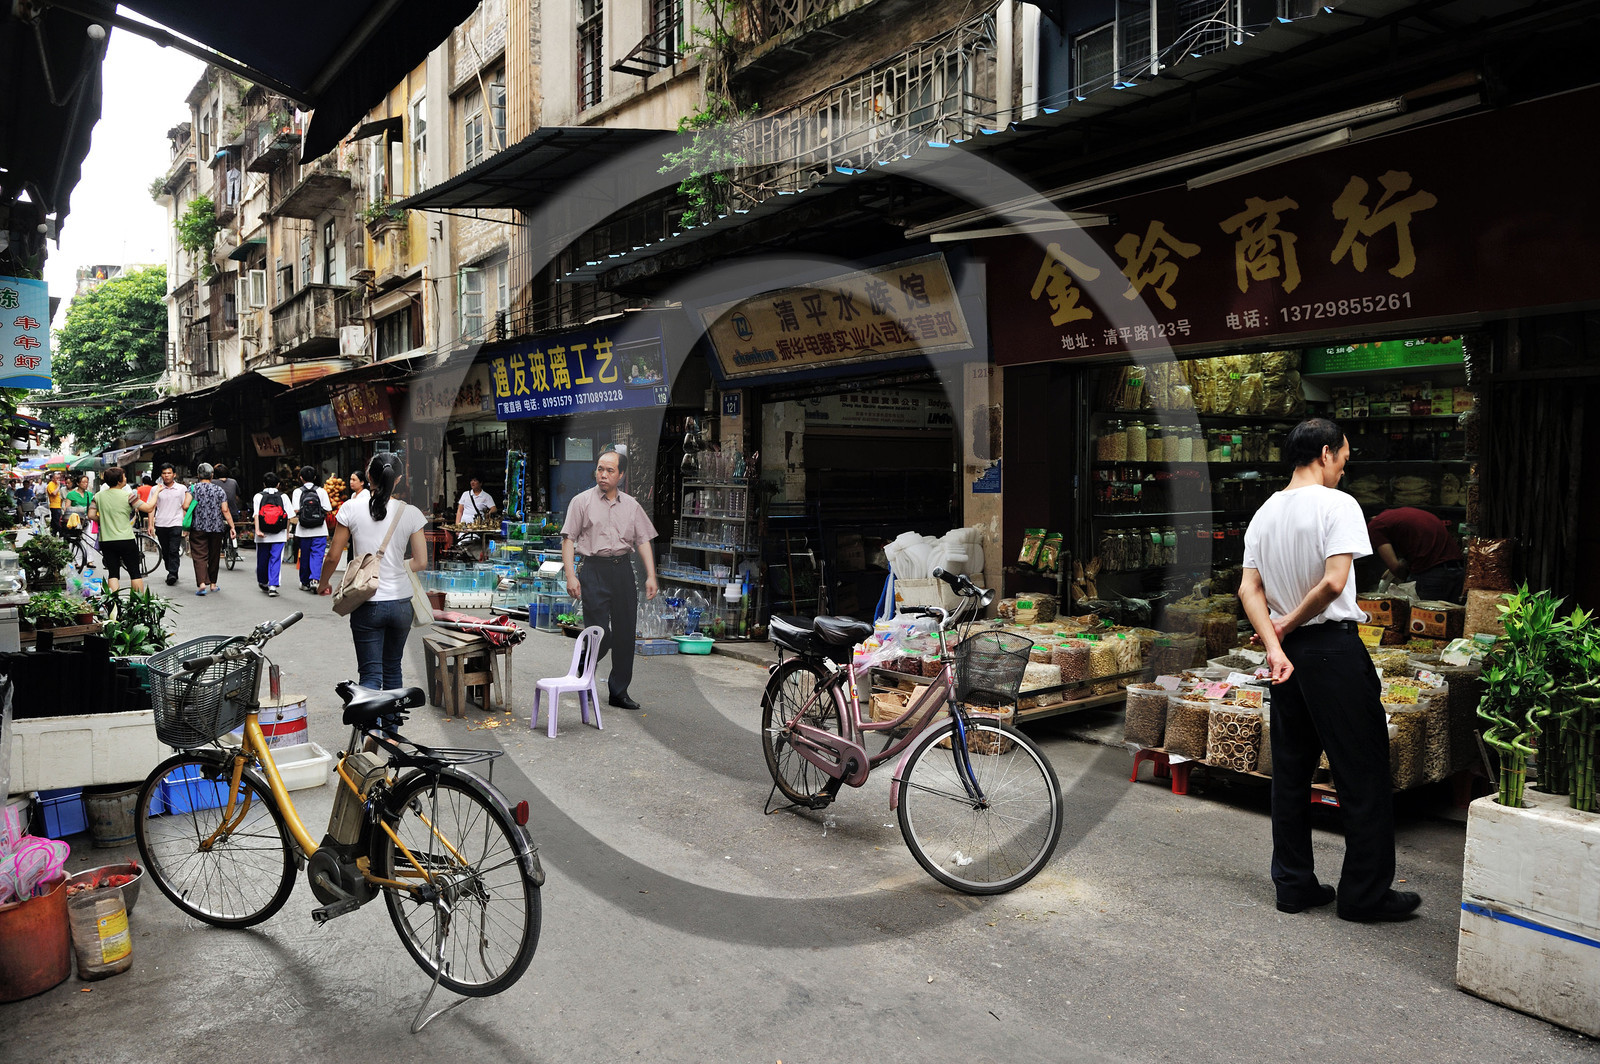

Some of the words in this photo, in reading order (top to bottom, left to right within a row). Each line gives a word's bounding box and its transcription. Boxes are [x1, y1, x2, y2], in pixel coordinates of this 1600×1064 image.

[1030, 169, 1439, 327] 金玲商行
[773, 272, 931, 333] 清平水族馆
[776, 310, 958, 361] 振华电器实业公司经营部
[491, 336, 618, 398] 通发玻璃工艺
[497, 400, 523, 414] 厂家直销
[575, 390, 623, 405] 13710893228
[657, 392, 667, 404] 119
[726, 402, 736, 413] 121
